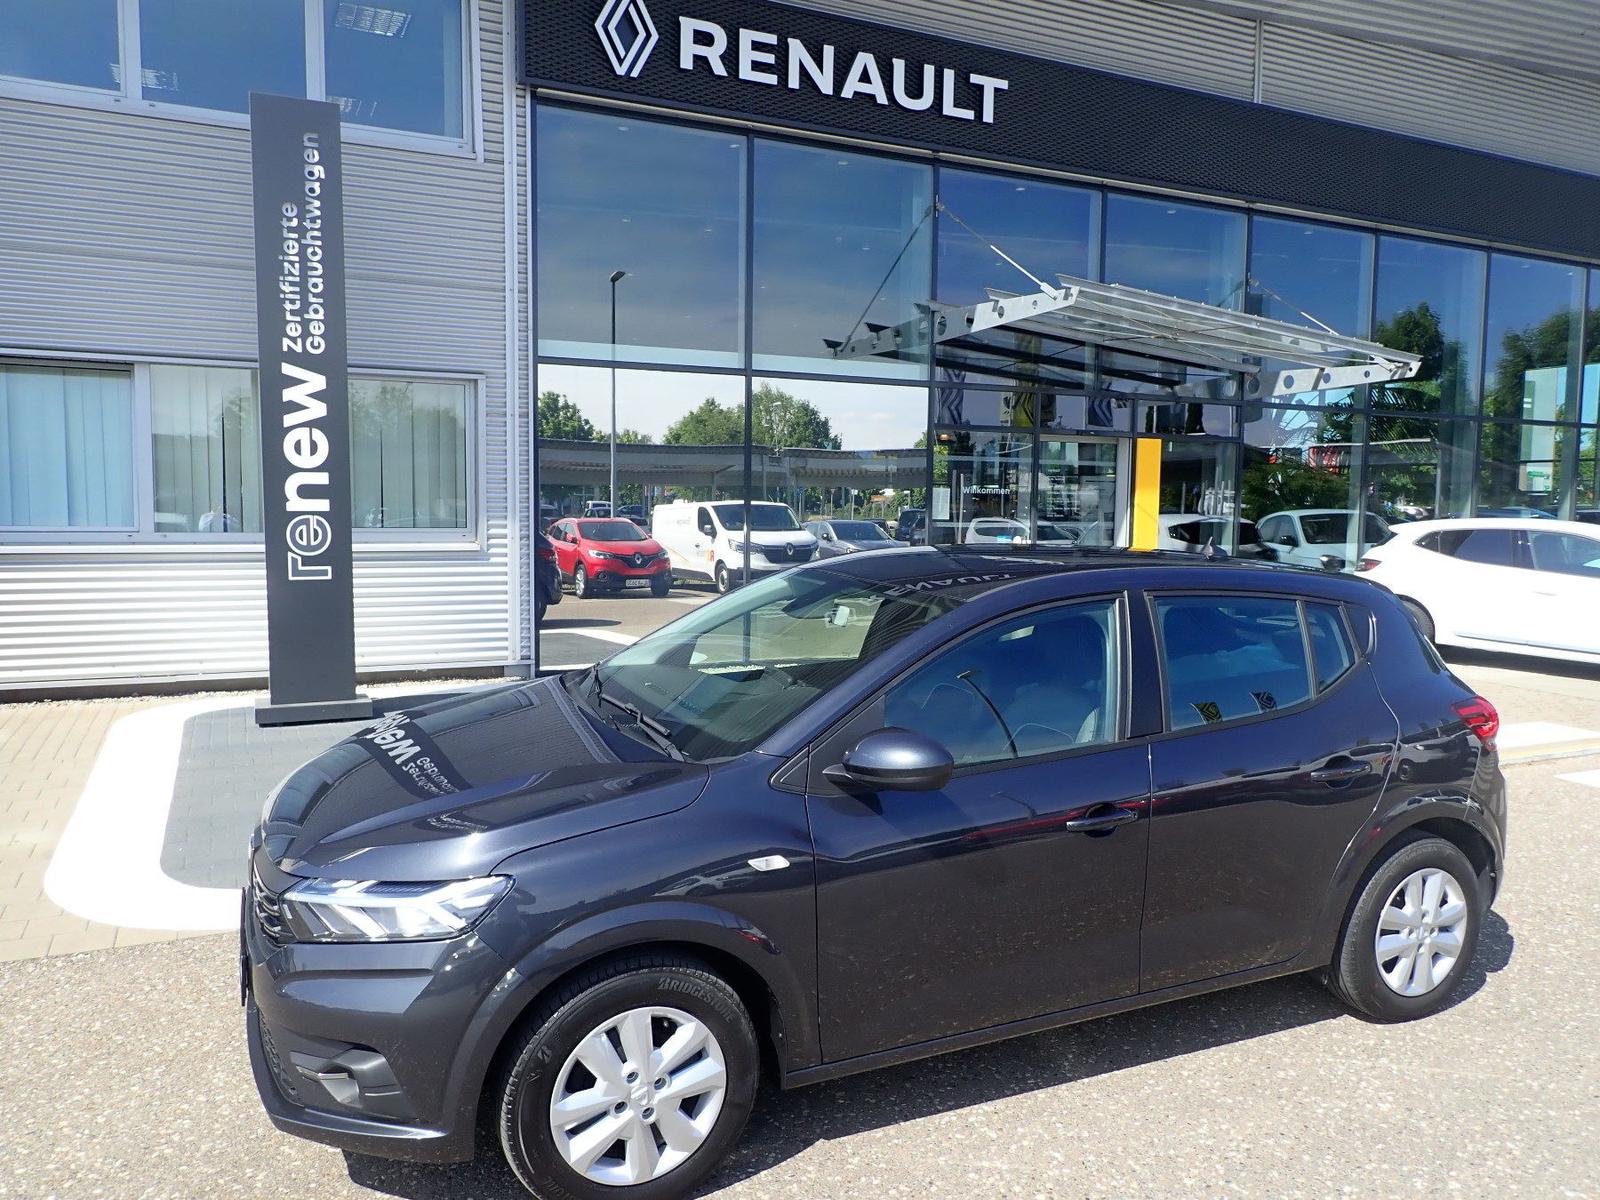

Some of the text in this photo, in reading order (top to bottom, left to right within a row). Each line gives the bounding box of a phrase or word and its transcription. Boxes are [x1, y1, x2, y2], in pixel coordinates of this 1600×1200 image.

[678, 15, 1009, 124] RENAULT
[279, 201, 303, 353] Zertifizierte
[300, 132, 326, 355] Gebrauchtwagen
[281, 362, 333, 581] renew
[962, 486, 1011, 495] Willkommen
[657, 977, 733, 1023] BRIDGESTONE
